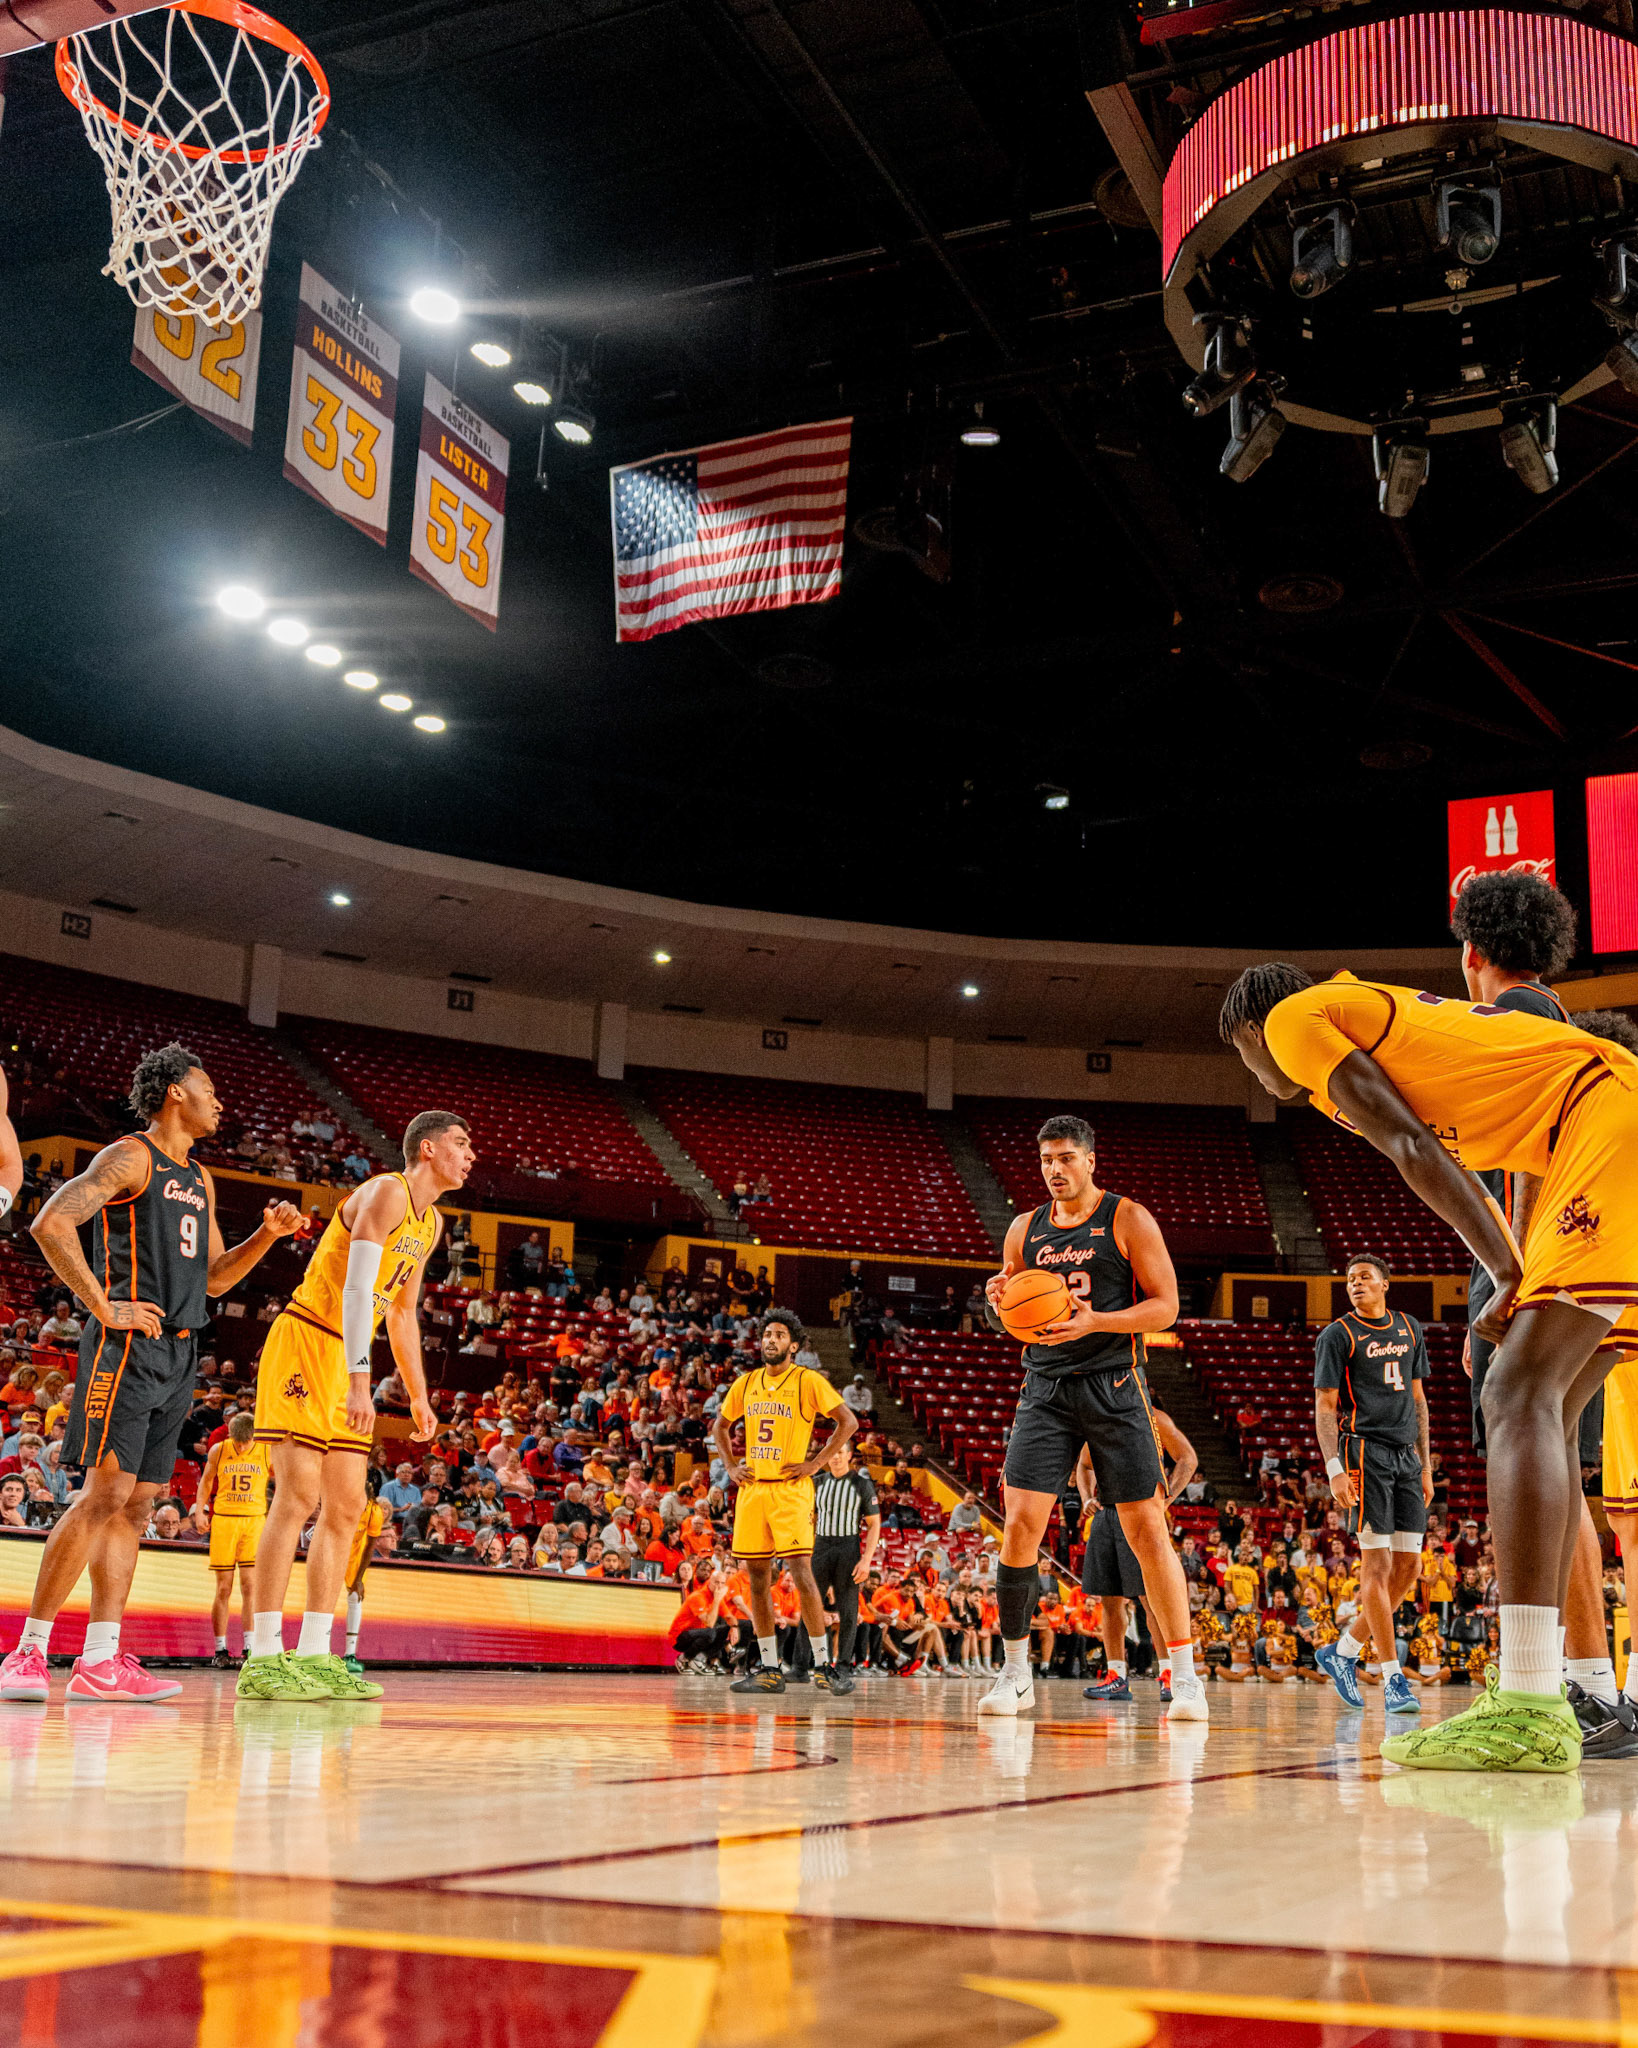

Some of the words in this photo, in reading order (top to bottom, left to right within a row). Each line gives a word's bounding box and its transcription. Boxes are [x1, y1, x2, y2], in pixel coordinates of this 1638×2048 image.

[321, 300, 380, 360] BASKETBALL
[312, 325, 383, 399] HOLLINS
[302, 373, 381, 500] 33
[441, 406, 493, 459] BASKETBALL
[440, 435, 488, 492] LISTER
[426, 476, 492, 588] 53
[163, 1179, 206, 1212] Cowboys
[180, 1213, 199, 1259] 9
[1035, 1244, 1096, 1266] Cowboys
[1053, 1270, 1092, 1310] 2
[1366, 1341, 1410, 1358] Cowboys
[1384, 1361, 1405, 1391] 4
[87, 1371, 115, 1419] POKES
[746, 1402, 793, 1419] ARIZONA
[757, 1419, 775, 1443] 5
[223, 1463, 262, 1475] ARIZONA
[231, 1474, 252, 1492] 15
[226, 1492, 255, 1503] STATE
